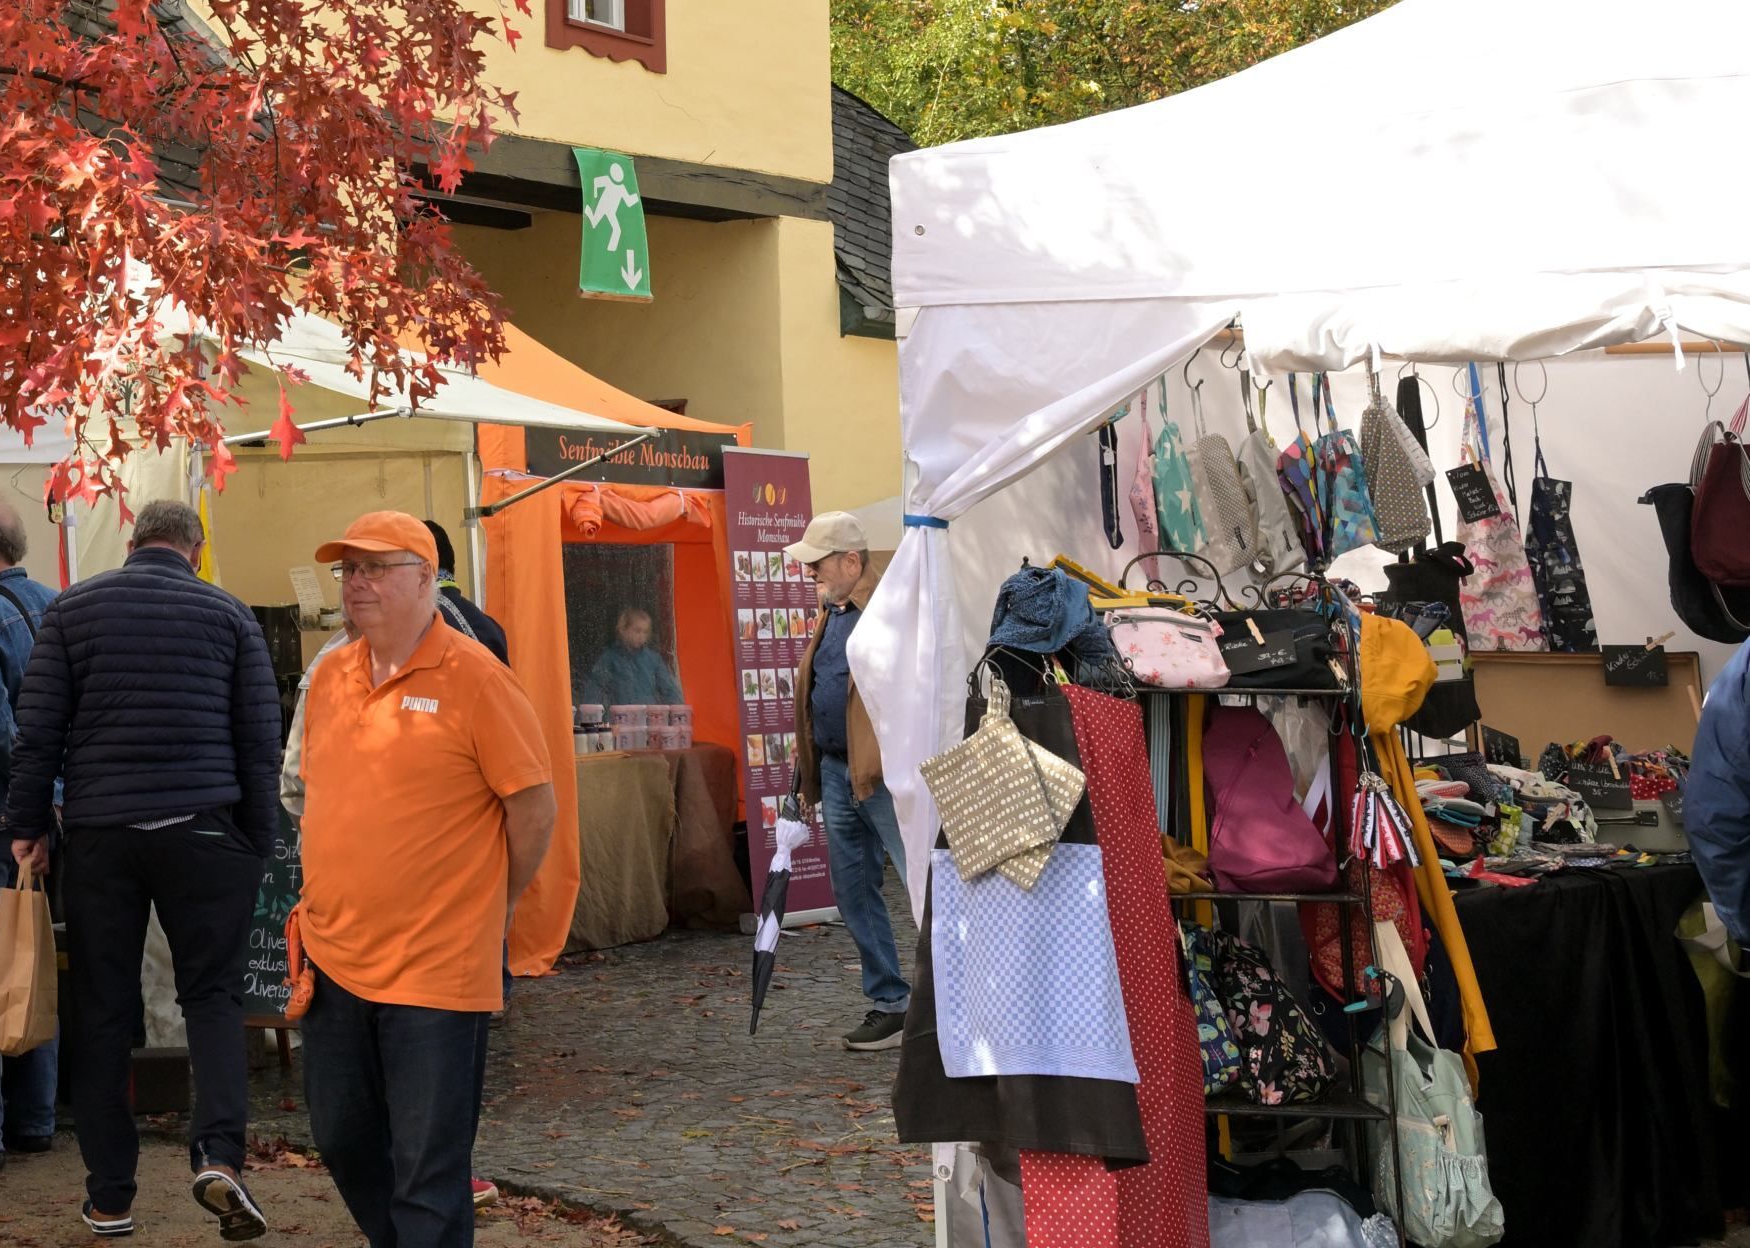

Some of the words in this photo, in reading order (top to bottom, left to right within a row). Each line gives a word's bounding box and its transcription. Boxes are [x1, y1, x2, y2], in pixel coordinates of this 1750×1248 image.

[640, 443, 710, 470] Monschau
[738, 512, 772, 527] Historische
[774, 514, 806, 532] Senfmühle
[757, 529, 790, 543] Monschau
[401, 696, 439, 713] PUMA
